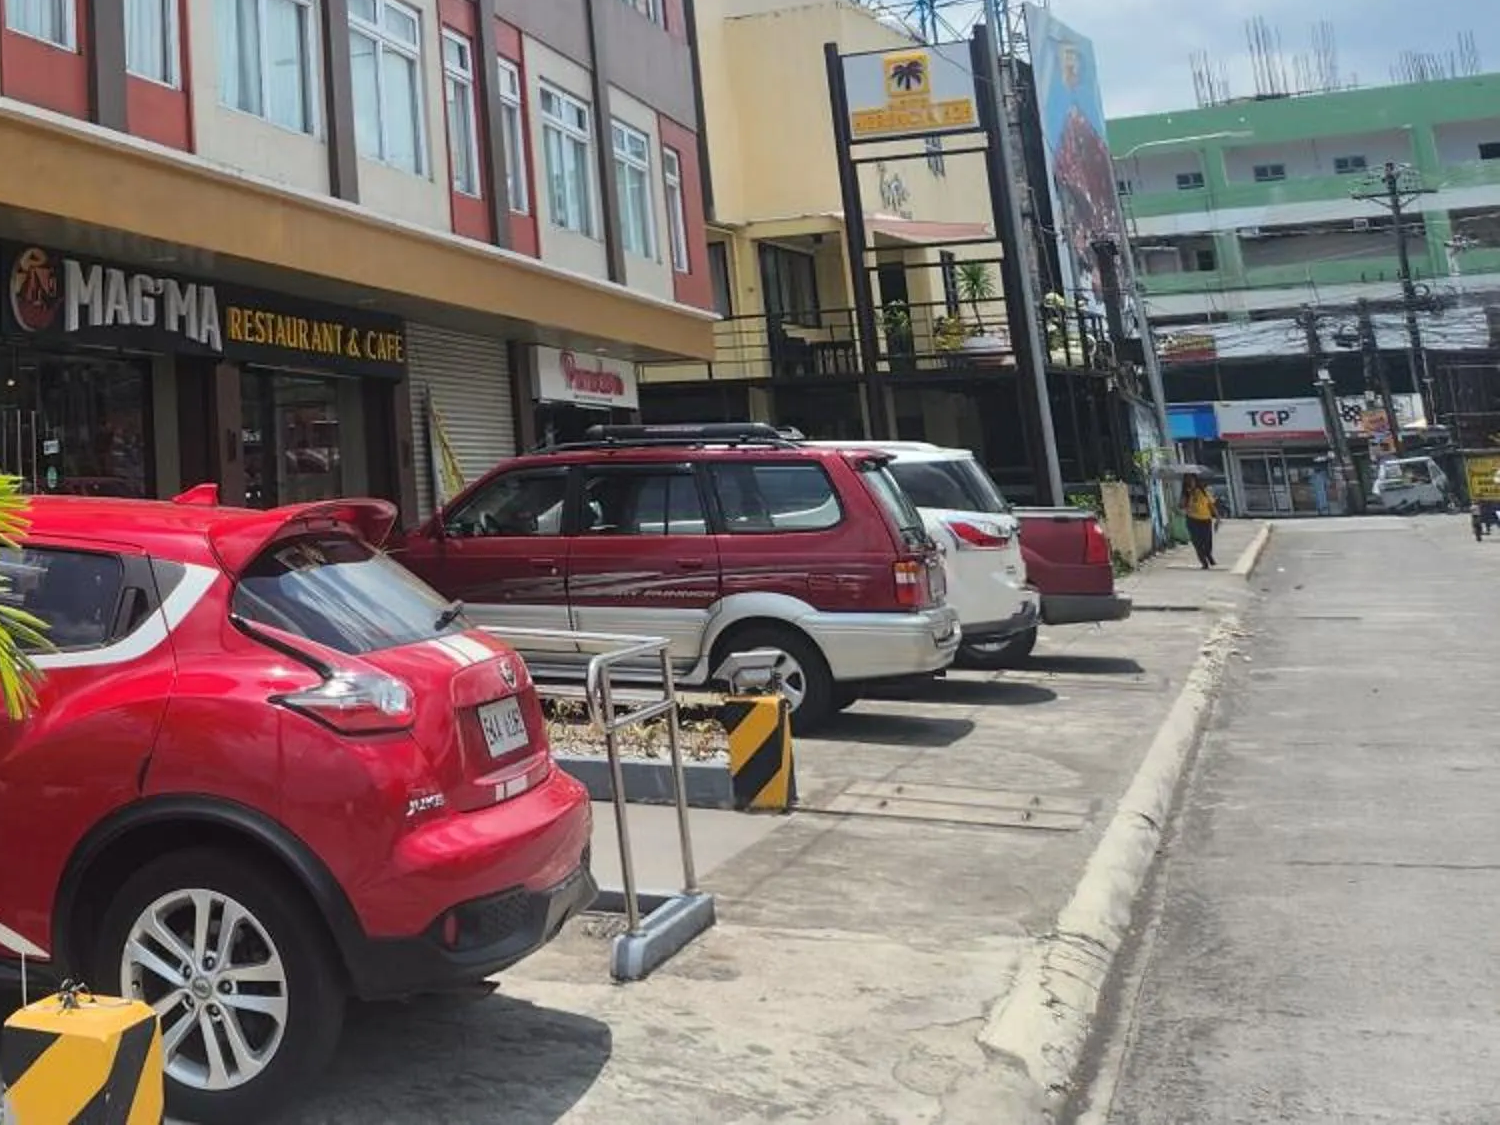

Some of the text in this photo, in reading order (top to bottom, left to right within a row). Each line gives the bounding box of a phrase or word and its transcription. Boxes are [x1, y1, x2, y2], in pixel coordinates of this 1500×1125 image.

[227, 307, 343, 354] RESTAURANT
[347, 328, 361, 358] &
[1246, 409, 1290, 427] TGP
